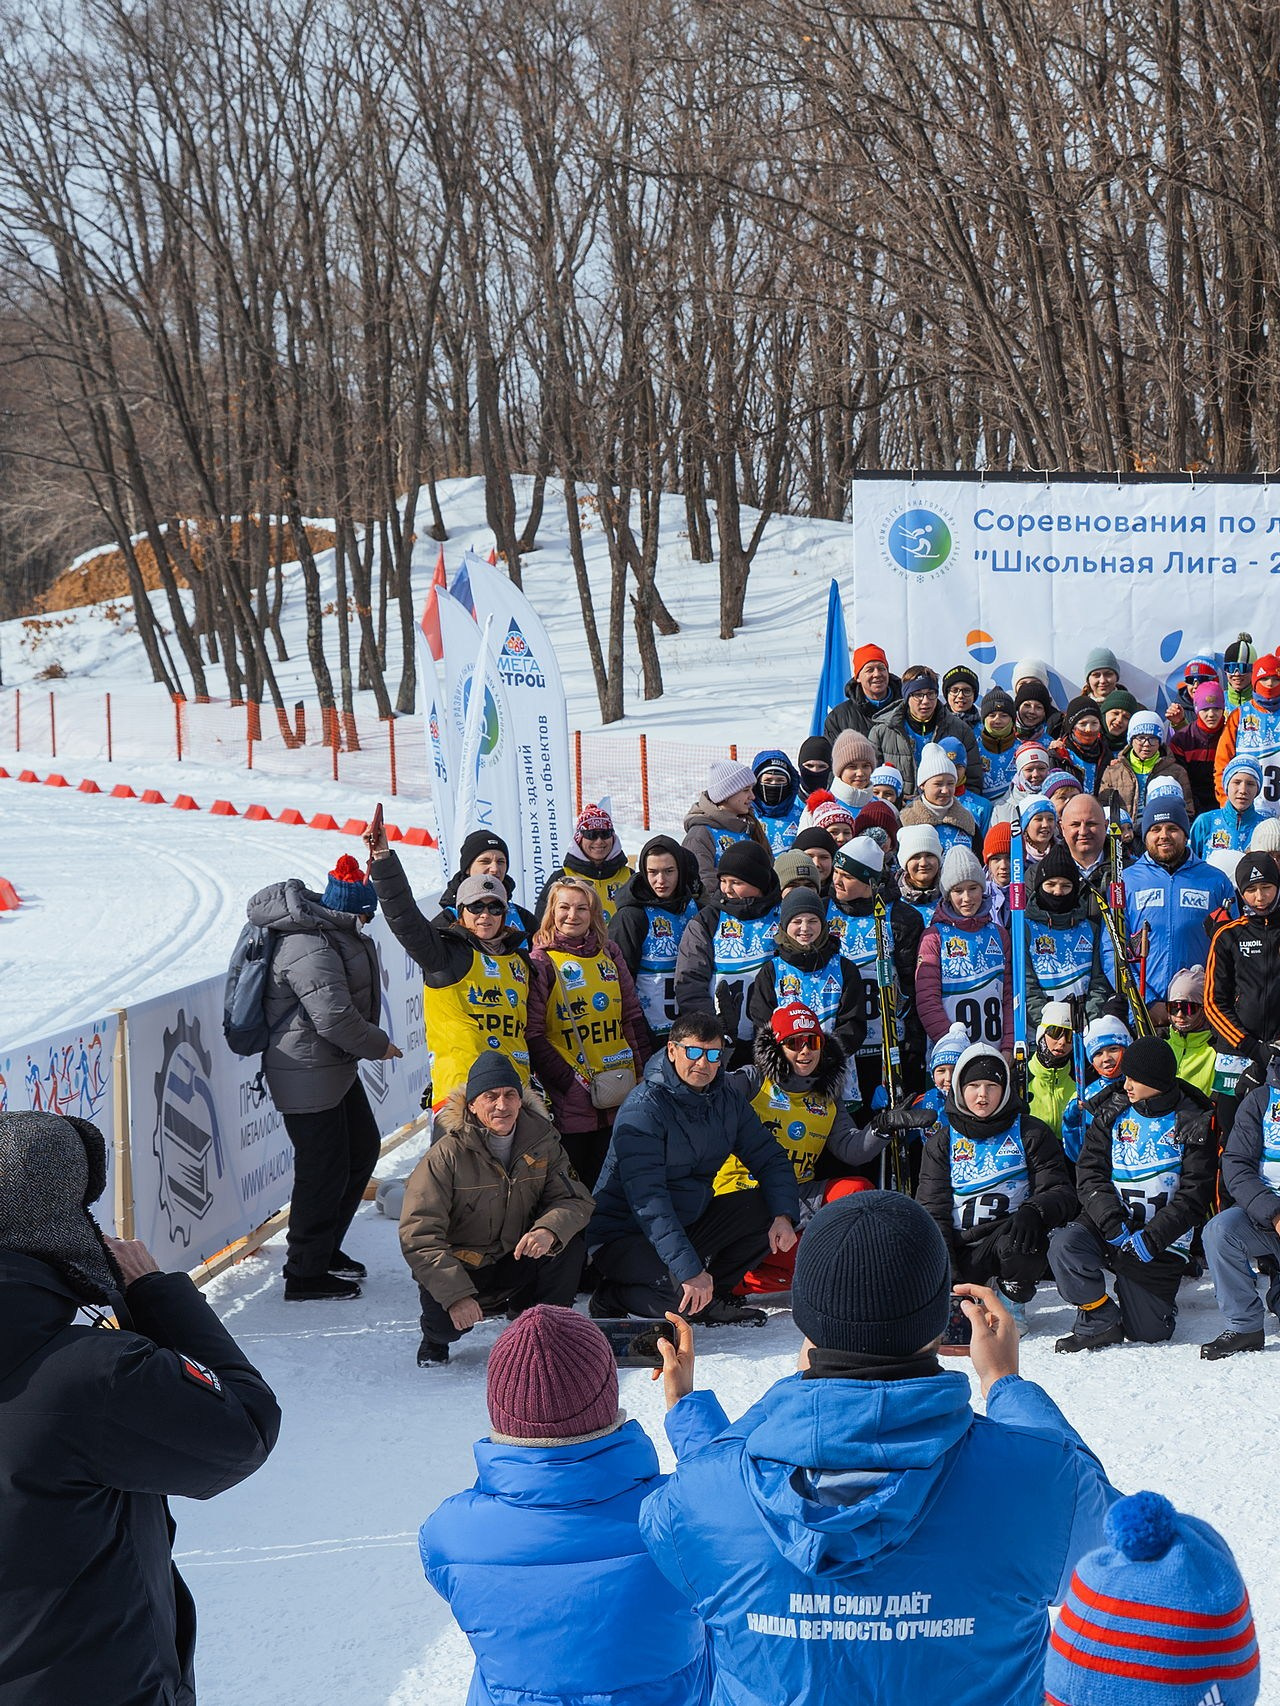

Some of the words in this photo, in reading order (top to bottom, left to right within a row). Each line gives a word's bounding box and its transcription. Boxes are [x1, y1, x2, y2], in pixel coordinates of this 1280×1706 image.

[973, 508, 1206, 537] Соревнования
[1219, 515, 1256, 534] по
[1162, 551, 1237, 574] Лига
[497, 656, 541, 673] МЕГА
[538, 714, 556, 792] объектов
[518, 744, 538, 806] зданий
[546, 799, 564, 869] ртивных
[529, 812, 547, 905] одульных
[1113, 884, 1123, 906] SWIX
[955, 996, 1002, 1043] 98
[240, 1146, 294, 1202] WWW.VALKOM
[961, 1192, 1011, 1229] 13
[1120, 1188, 1169, 1225] 51
[789, 1593, 830, 1614] НАМ
[833, 1594, 883, 1616] СИЛУ
[884, 1591, 932, 1618] ДАЁТ
[746, 1613, 798, 1639] НАША
[799, 1620, 893, 1641] ВЕРНОСТЬ
[896, 1617, 976, 1641] ОТЧИЗНЕ
